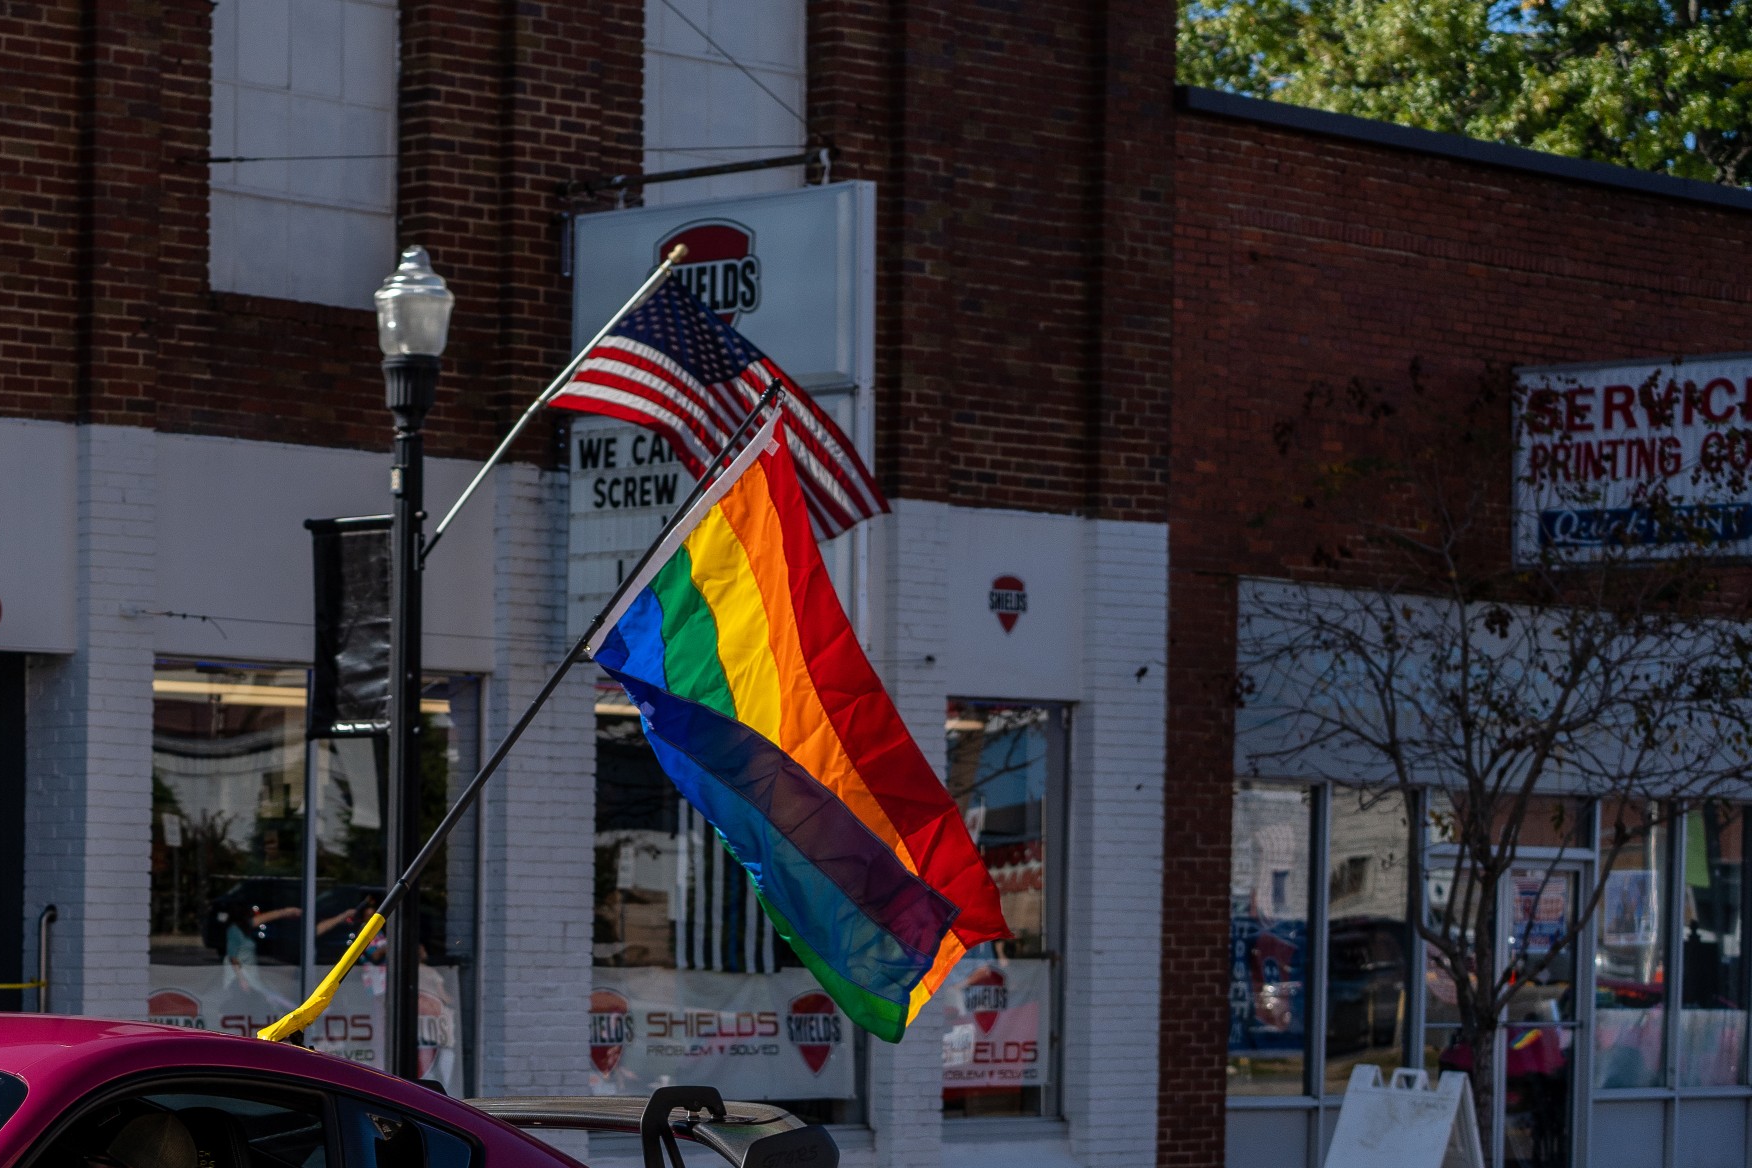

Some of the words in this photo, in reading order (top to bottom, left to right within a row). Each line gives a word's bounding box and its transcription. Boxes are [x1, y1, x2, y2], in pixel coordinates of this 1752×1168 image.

[1528, 377, 1752, 433] SERVIC
[580, 438, 616, 469] WE
[1532, 437, 1681, 482] PRINTING
[594, 474, 678, 508] SCREW
[989, 591, 1026, 611] SHIELDS
[646, 1013, 778, 1037] SHIELDS
[786, 1016, 841, 1042] SHIELDS
[647, 1044, 713, 1056] PROBLEM
[729, 1044, 779, 1056] SOLVED
